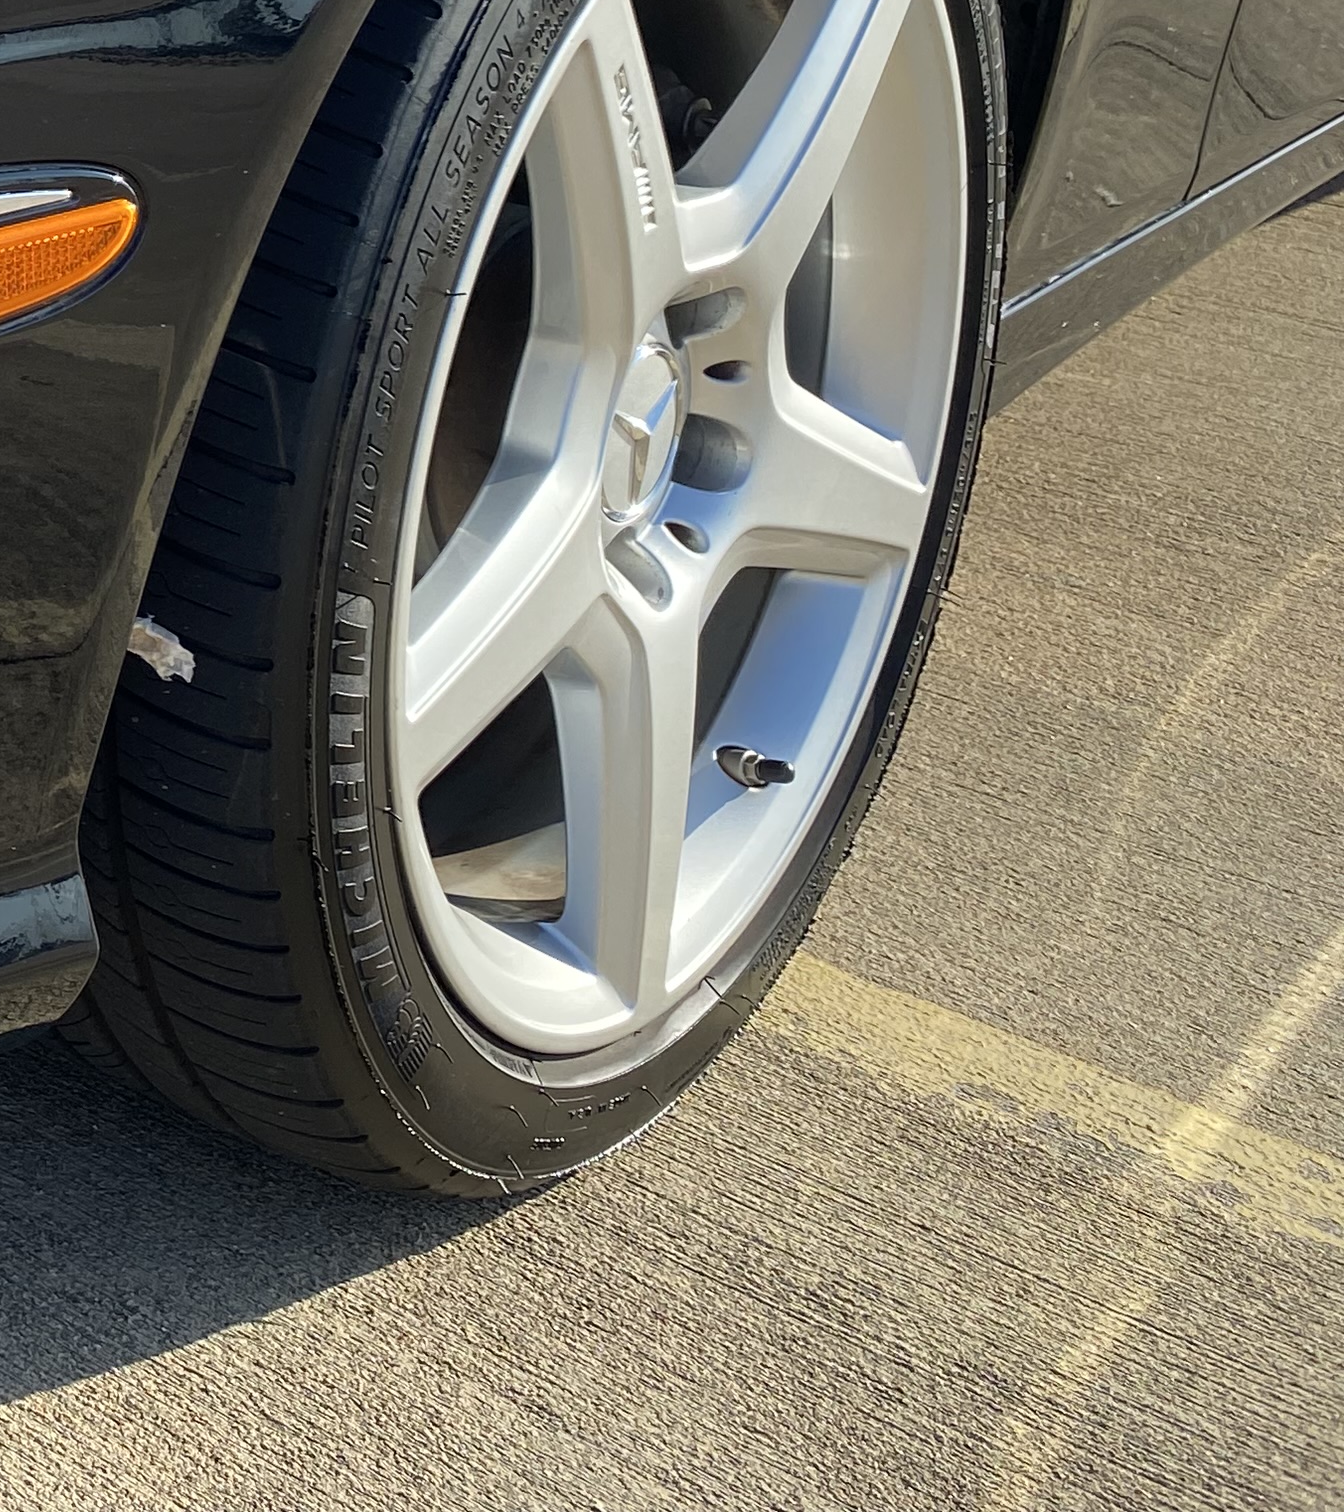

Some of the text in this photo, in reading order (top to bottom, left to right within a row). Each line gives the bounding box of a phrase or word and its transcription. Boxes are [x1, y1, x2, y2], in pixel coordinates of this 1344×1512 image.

[483, 110, 505, 147] MAX
[502, 61, 526, 105] LOAD
[491, 121, 512, 158] MAX
[510, 62, 541, 115] PRESS
[349, 433, 386, 551] PILOT
[374, 284, 420, 428] SPORT
[416, 204, 450, 276] ALL
[444, 33, 515, 188] SEASON
[329, 616, 409, 1006] MICHELIN
